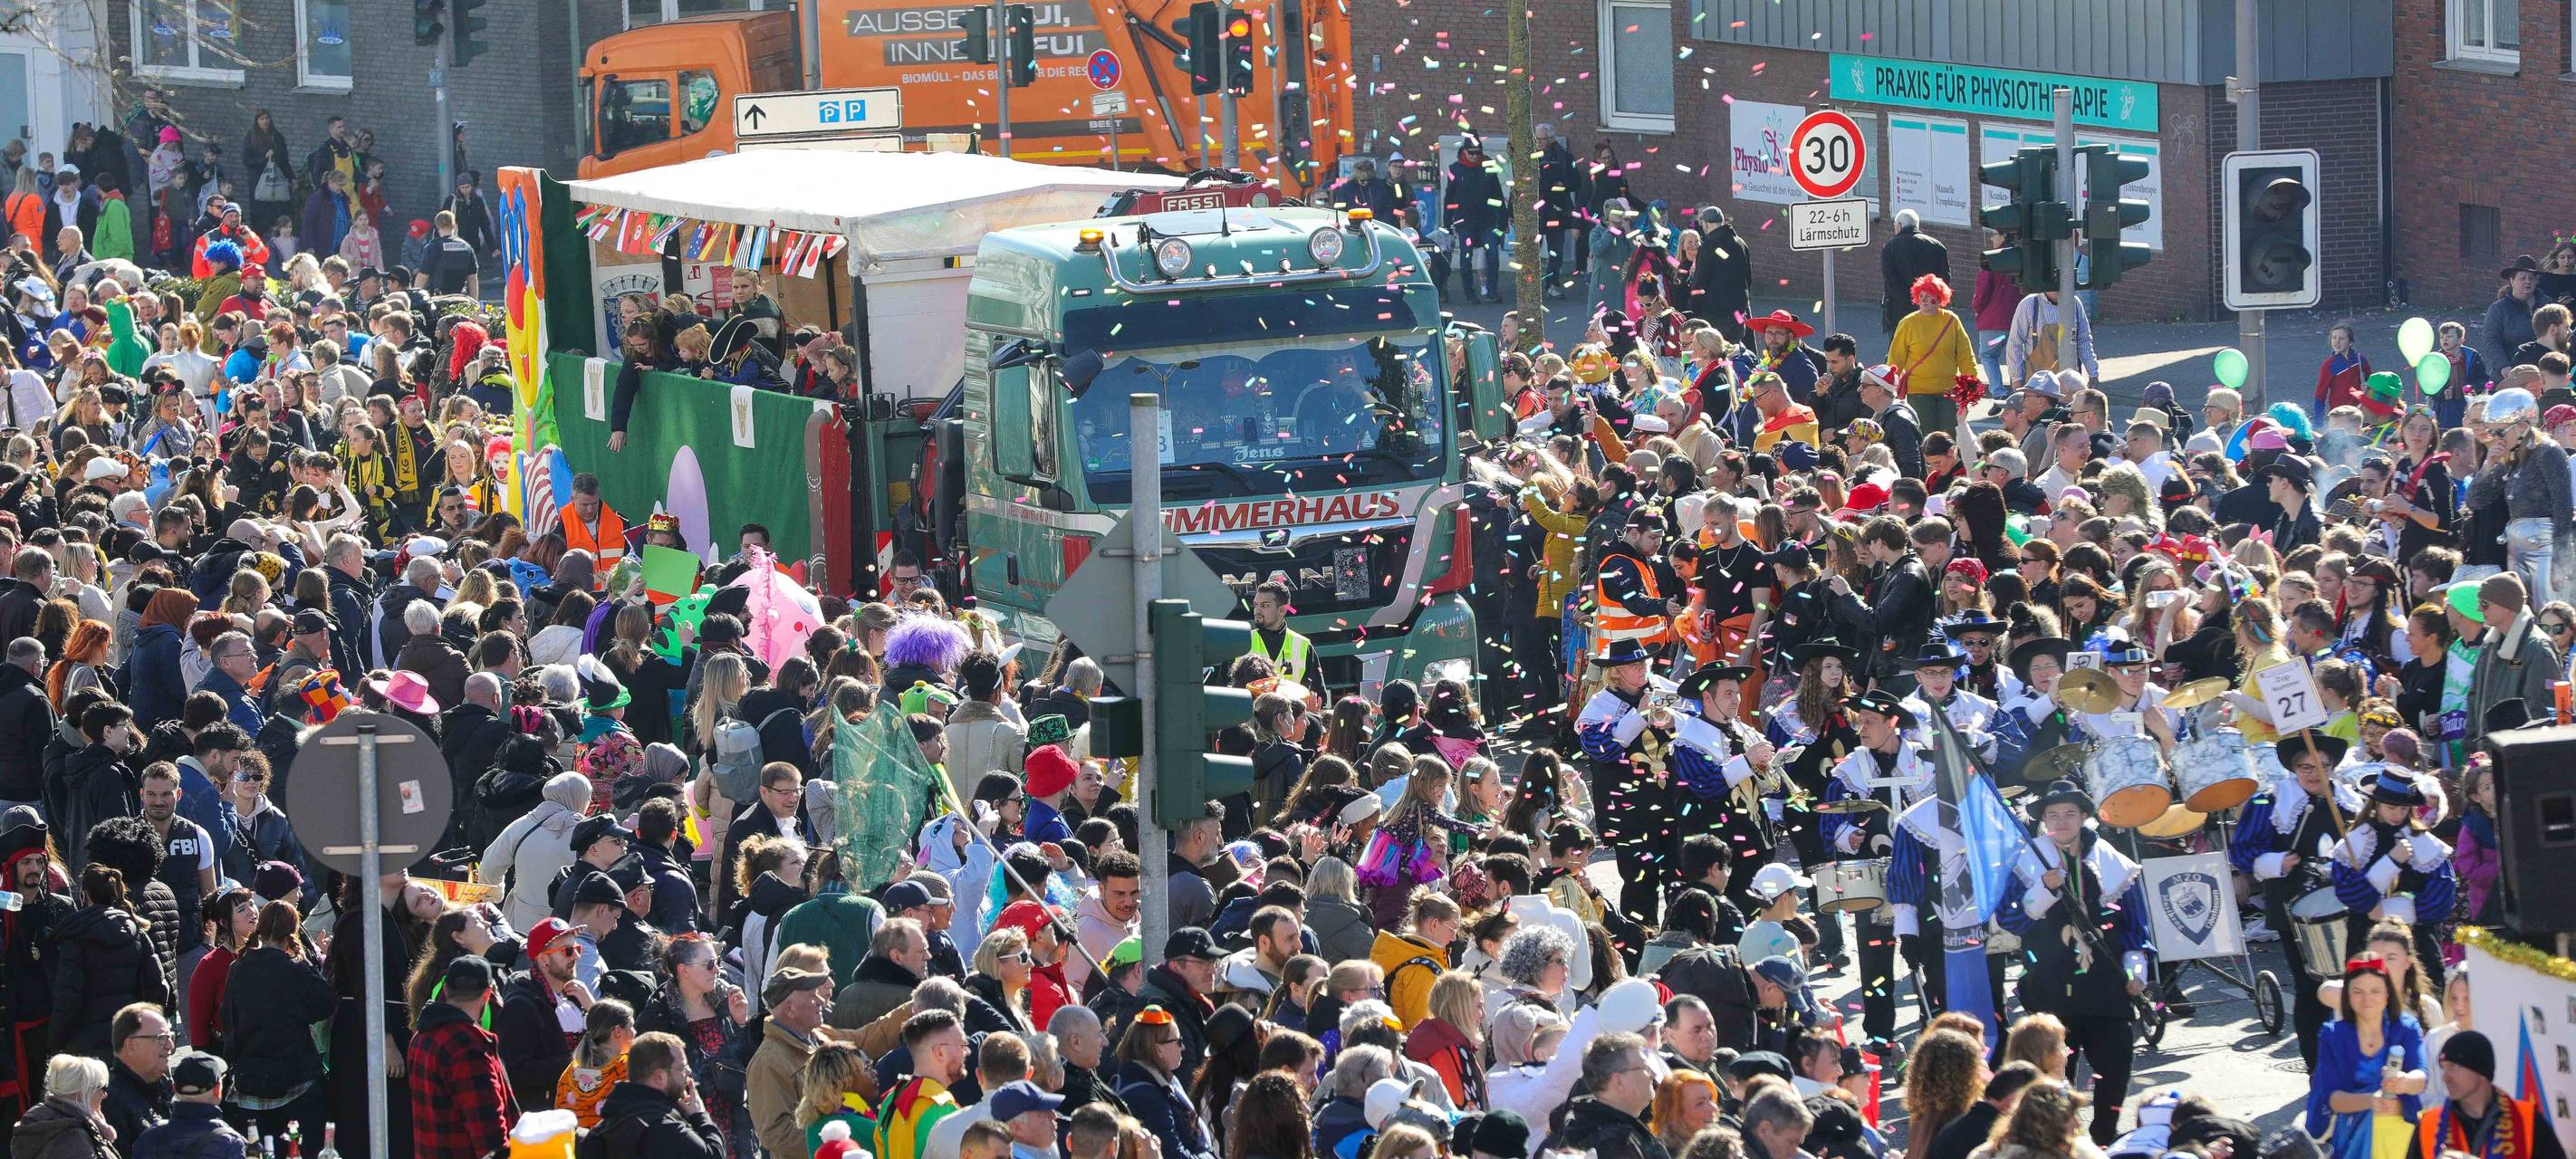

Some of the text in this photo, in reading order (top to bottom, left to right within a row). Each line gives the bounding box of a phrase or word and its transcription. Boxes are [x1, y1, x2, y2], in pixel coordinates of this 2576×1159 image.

[853, 8, 994, 34] AUSSE
[890, 38, 995, 62] INNE
[902, 71, 952, 84] BIOMÜLL
[962, 71, 985, 81] DAS
[1048, 67, 1062, 78] DIE
[1065, 66, 1088, 77] RES
[1876, 67, 1930, 100] PRAXIS
[1936, 67, 1966, 104] FÜR
[1734, 147, 1768, 177] Physio
[1806, 135, 1849, 174] 30
[1168, 196, 1219, 211] FASSI
[1800, 227, 1860, 241] Lärmschutz
[1233, 445, 1284, 462] Jens
[1162, 492, 1400, 533] IMMERHAUS
[1222, 566, 1334, 594] MAN
[2278, 691, 2305, 718] 27
[170, 838, 198, 856] FBI
